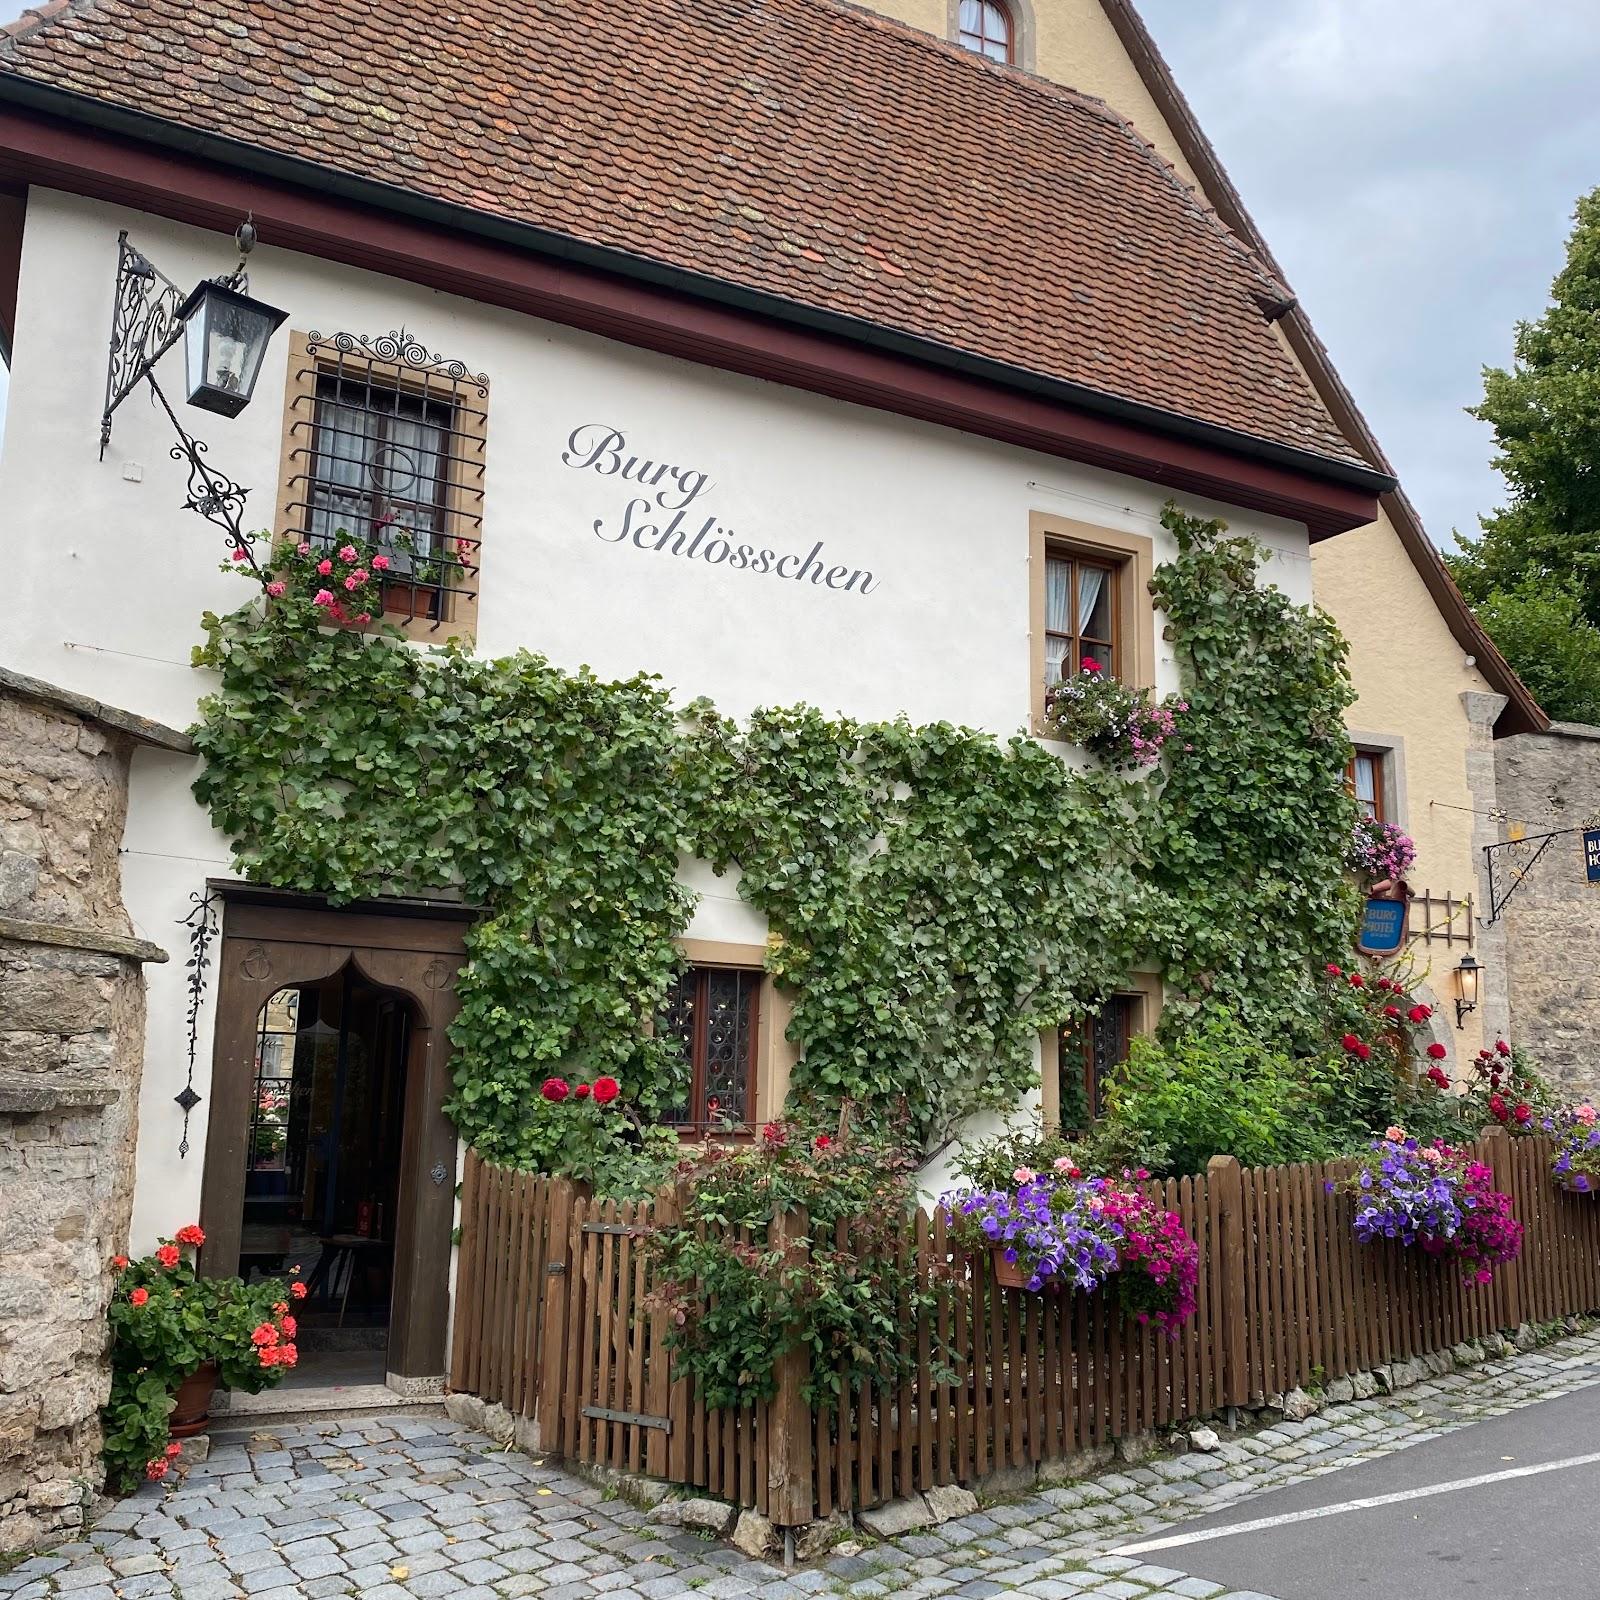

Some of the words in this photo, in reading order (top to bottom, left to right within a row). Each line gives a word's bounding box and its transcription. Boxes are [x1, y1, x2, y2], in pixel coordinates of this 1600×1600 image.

[562, 424, 718, 509] Burg
[593, 498, 880, 594] Schlösschen
[1368, 909, 1397, 921] BURG
